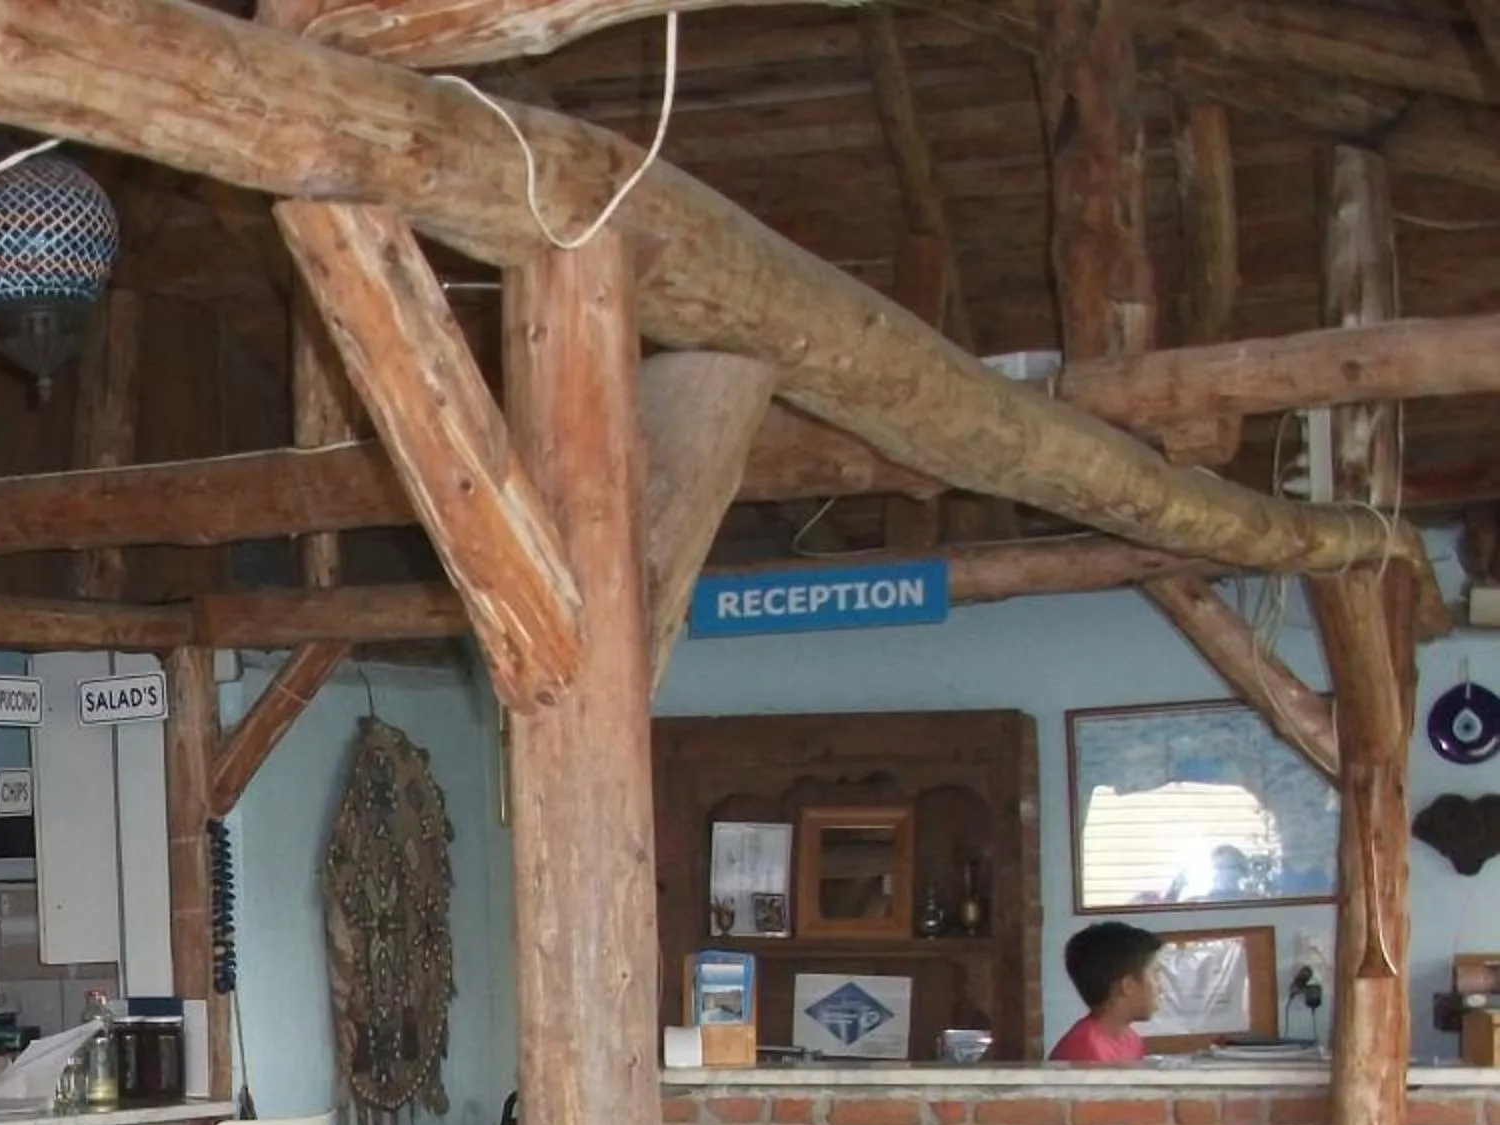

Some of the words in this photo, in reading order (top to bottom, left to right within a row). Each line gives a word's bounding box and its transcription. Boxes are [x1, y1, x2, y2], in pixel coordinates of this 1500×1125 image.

[717, 578, 924, 618] RECEPTION
[85, 686, 158, 713] SALAD'S
[1, 782, 29, 803] CHIPS
